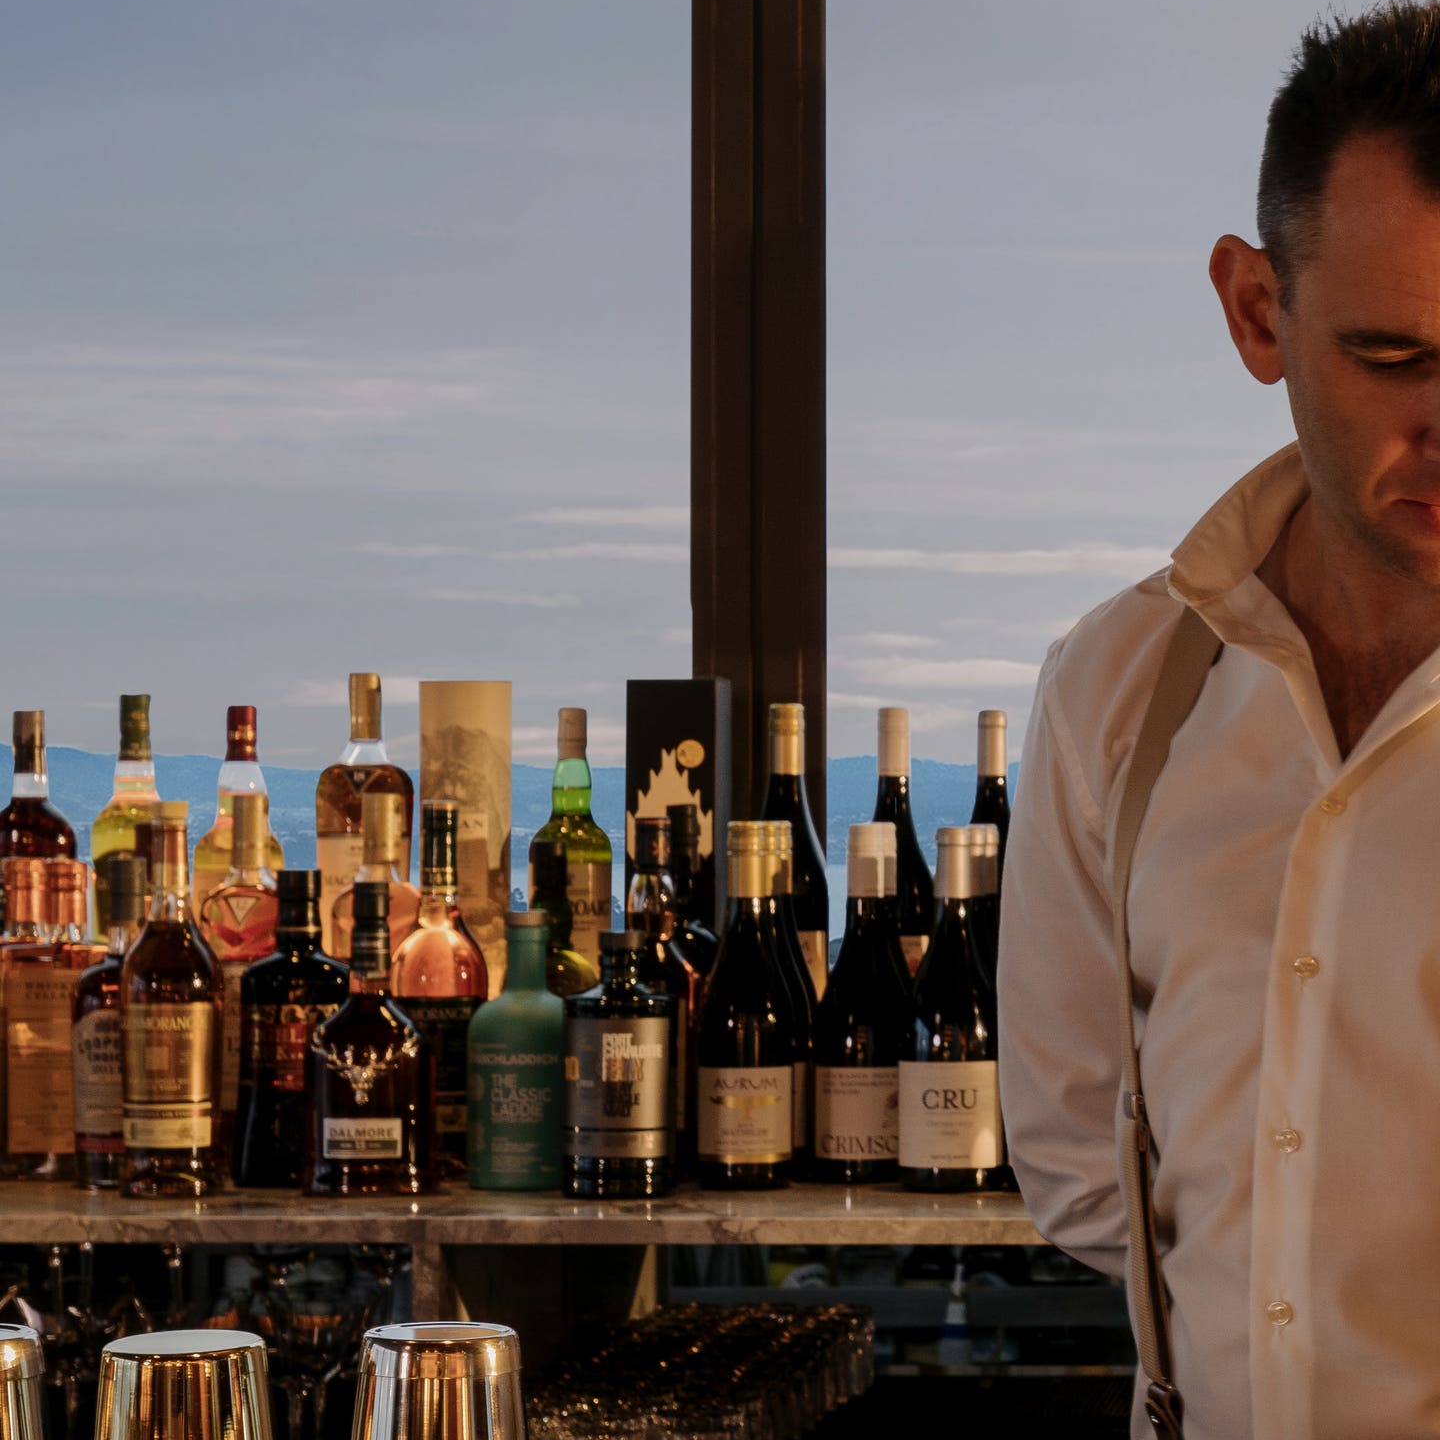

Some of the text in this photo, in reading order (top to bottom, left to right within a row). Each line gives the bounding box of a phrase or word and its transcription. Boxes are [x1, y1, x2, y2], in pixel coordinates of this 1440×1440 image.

[713, 1077, 778, 1091] AURUM
[921, 1088, 978, 1110] CRU
[329, 1127, 395, 1139] DALMORE
